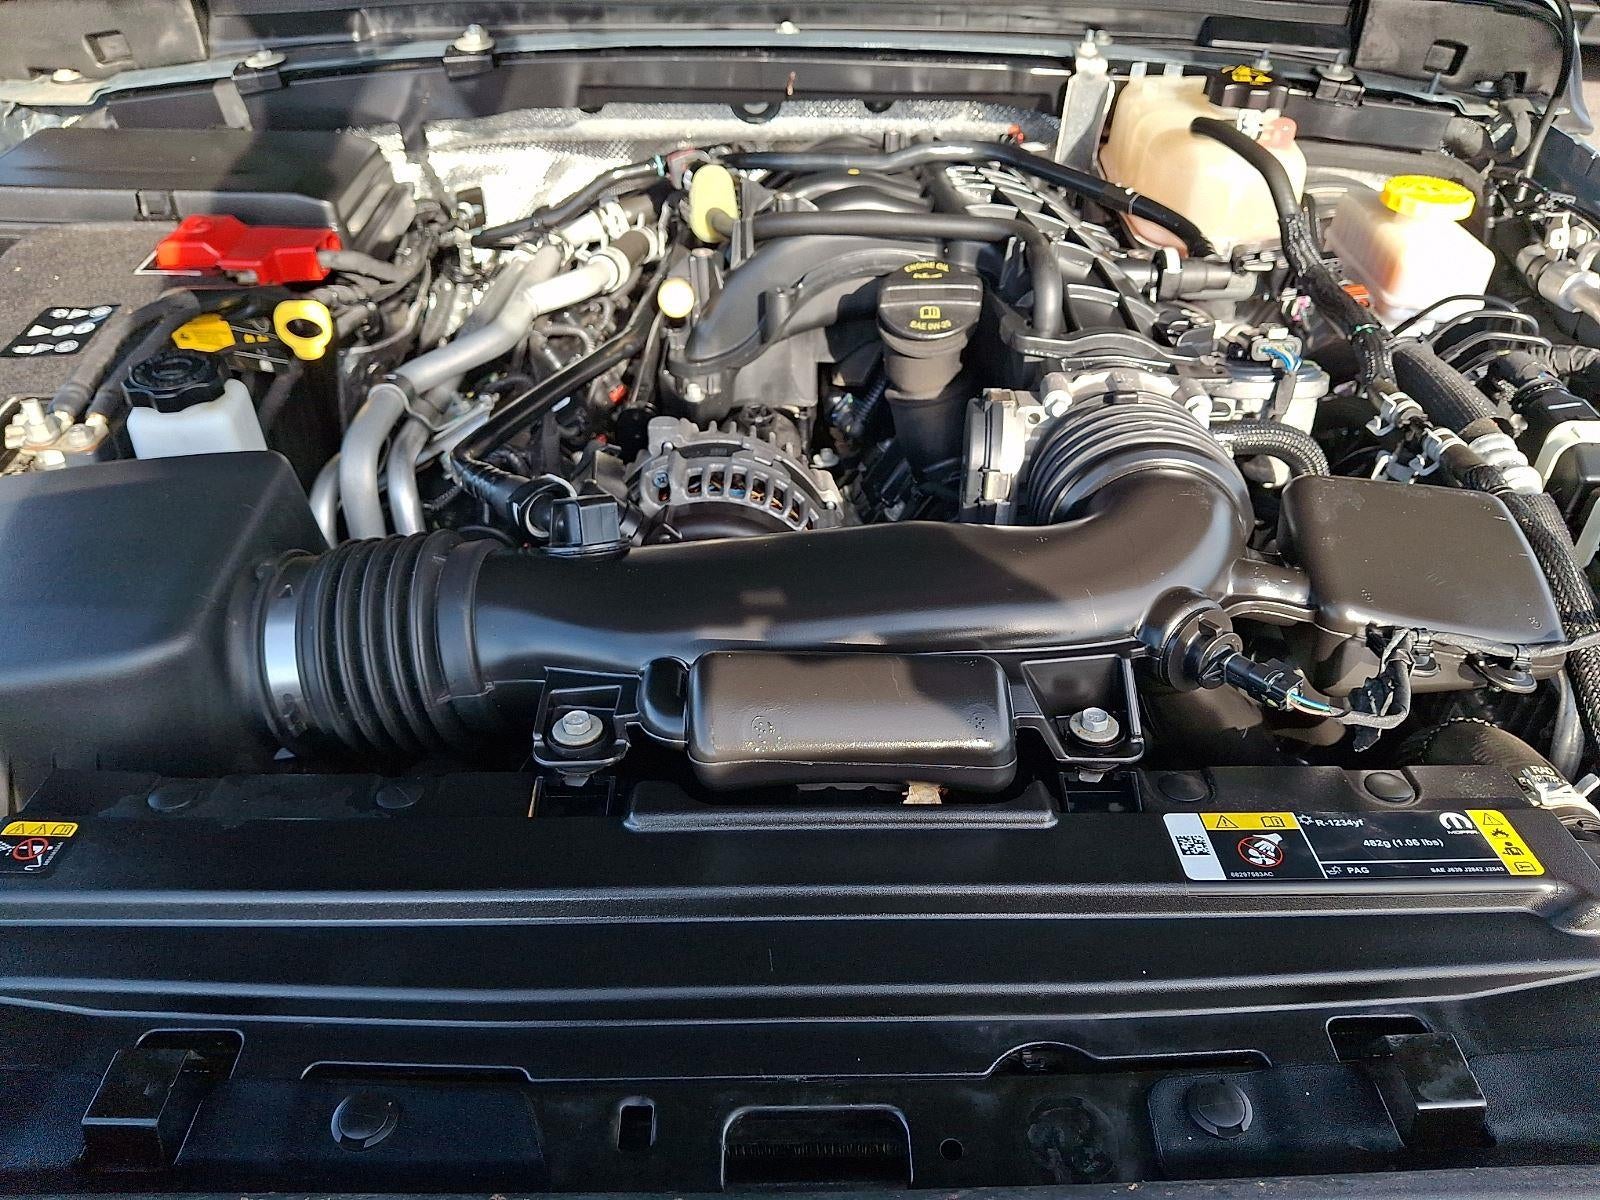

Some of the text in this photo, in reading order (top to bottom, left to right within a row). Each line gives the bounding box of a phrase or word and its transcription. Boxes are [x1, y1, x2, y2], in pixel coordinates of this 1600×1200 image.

[1530, 765, 1555, 776] RAD
[1315, 818, 1365, 828] R-1234yf
[1363, 839, 1392, 849] 482g
[1346, 866, 1370, 874] PAG
